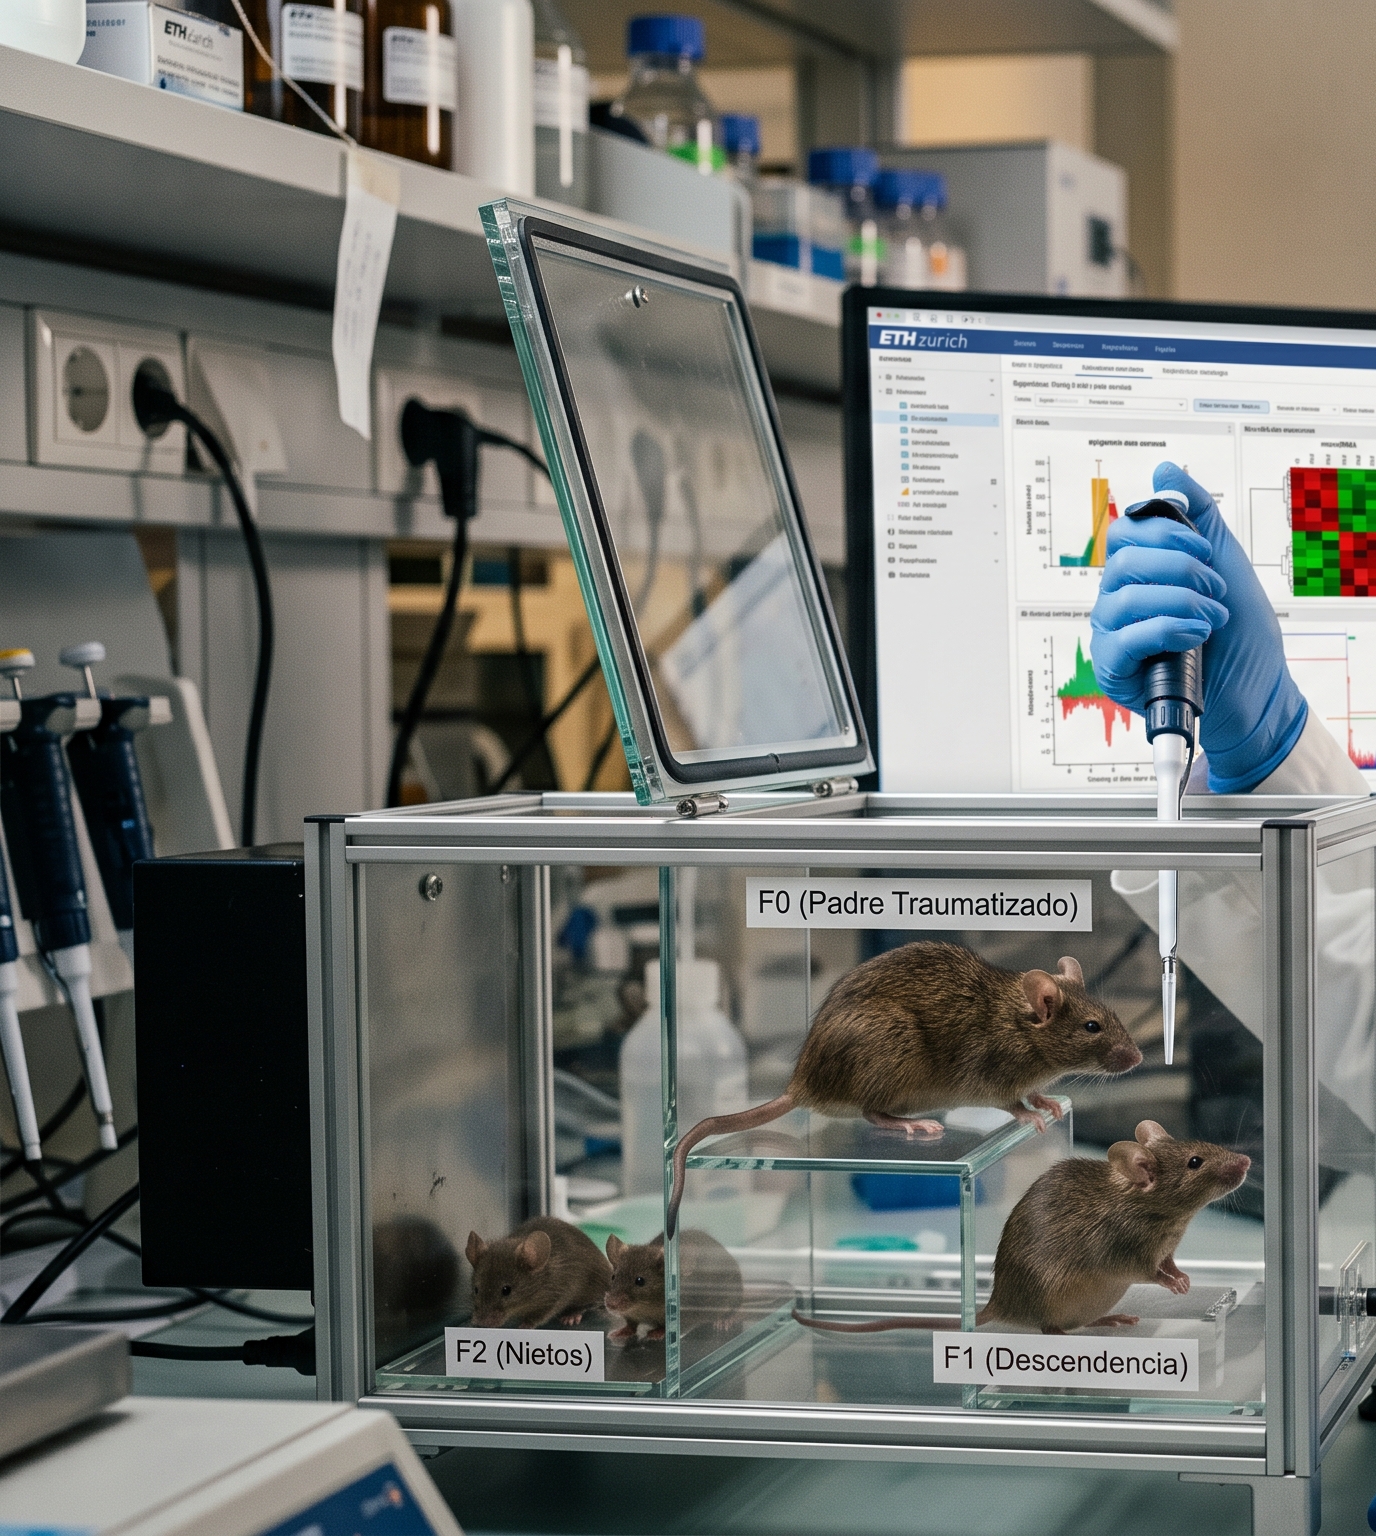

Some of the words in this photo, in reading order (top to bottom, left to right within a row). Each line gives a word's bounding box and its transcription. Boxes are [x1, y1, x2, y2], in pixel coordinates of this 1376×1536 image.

[759, 890, 790, 914] F0
[799, 889, 885, 920] (Padre
[892, 891, 1078, 923] Traumatizado)
[456, 1340, 487, 1364] F2
[497, 1340, 592, 1373] (Nietos)
[945, 1345, 974, 1370] F1
[986, 1346, 1188, 1382] (Descendencia)
